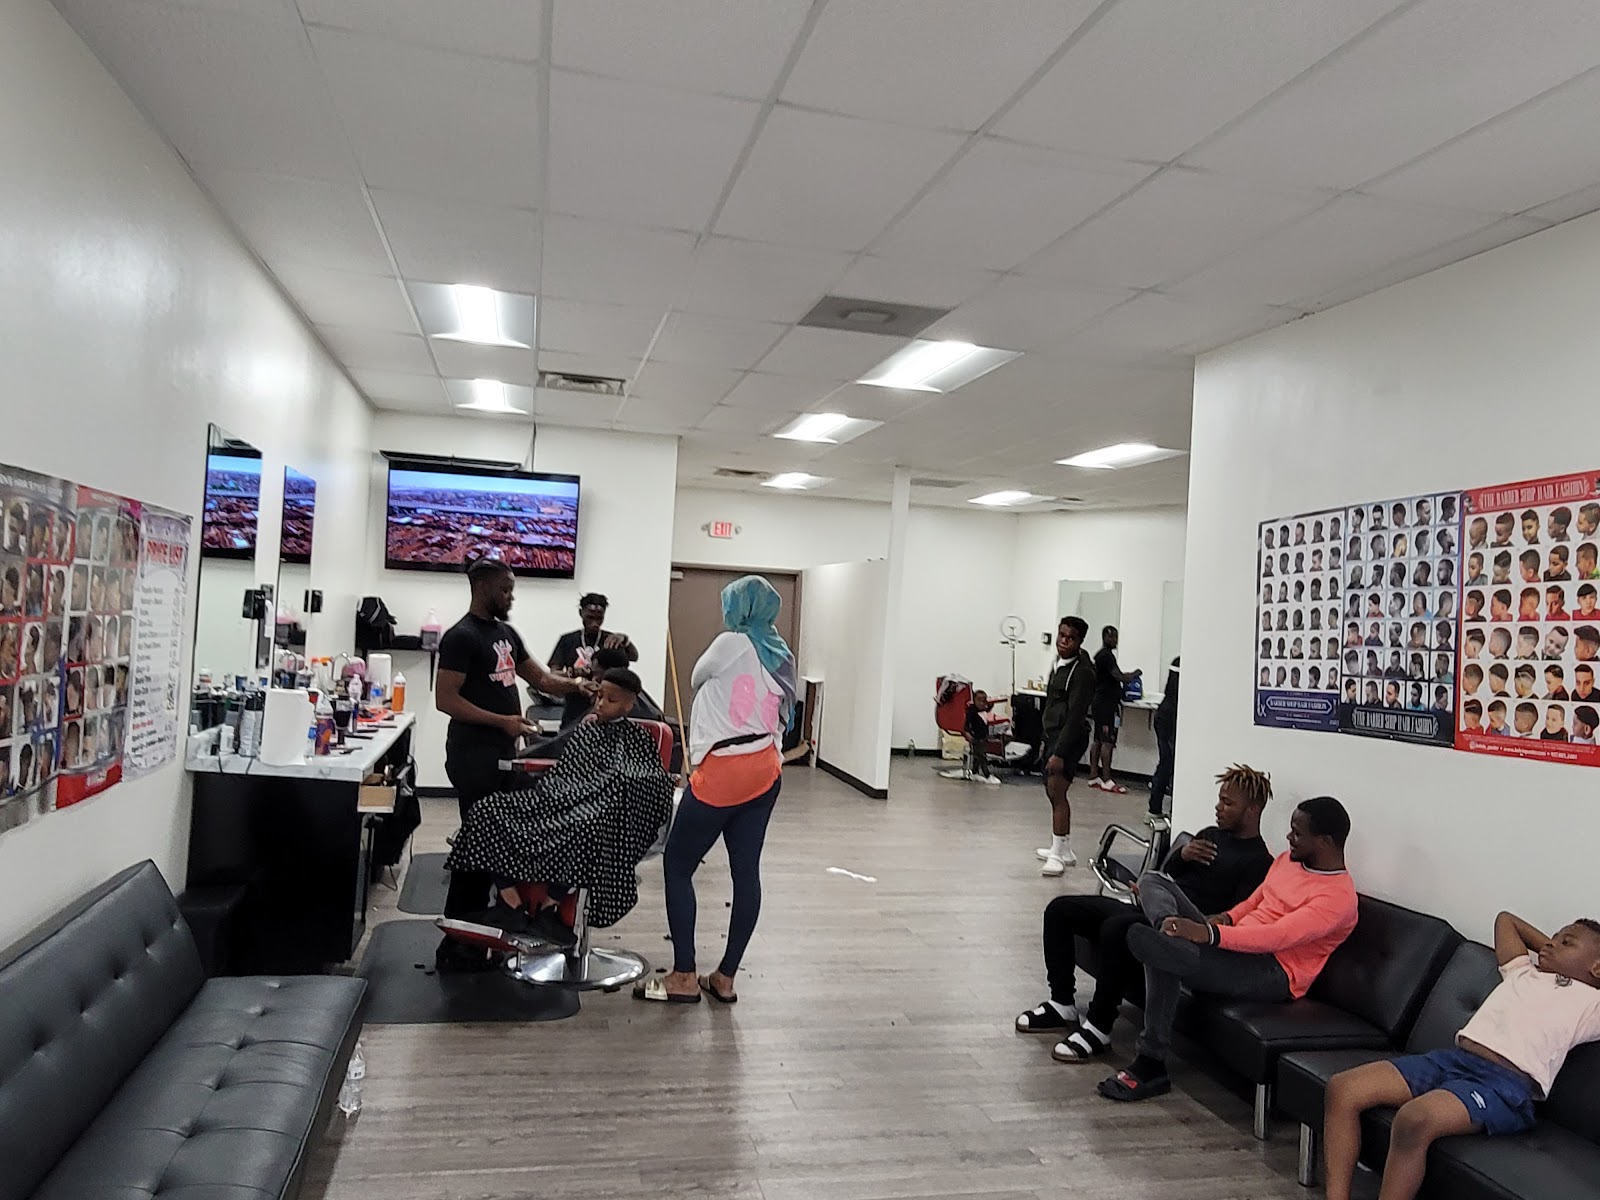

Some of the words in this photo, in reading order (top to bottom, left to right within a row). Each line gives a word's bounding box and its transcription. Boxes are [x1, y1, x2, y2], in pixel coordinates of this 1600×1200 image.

[1483, 493, 1494, 508] THE
[1496, 489, 1519, 507] BARBER
[1520, 486, 1536, 503] SHOP
[1537, 484, 1554, 501] HAIR
[714, 521, 732, 536] EXIT
[147, 539, 168, 564] PRICE
[169, 544, 183, 567] LIST
[1356, 710, 1366, 727] THE
[1366, 711, 1384, 729] BARBER
[1385, 713, 1397, 731] SHOP
[1397, 714, 1411, 732] HAIR
[1411, 716, 1433, 735] FASHION
